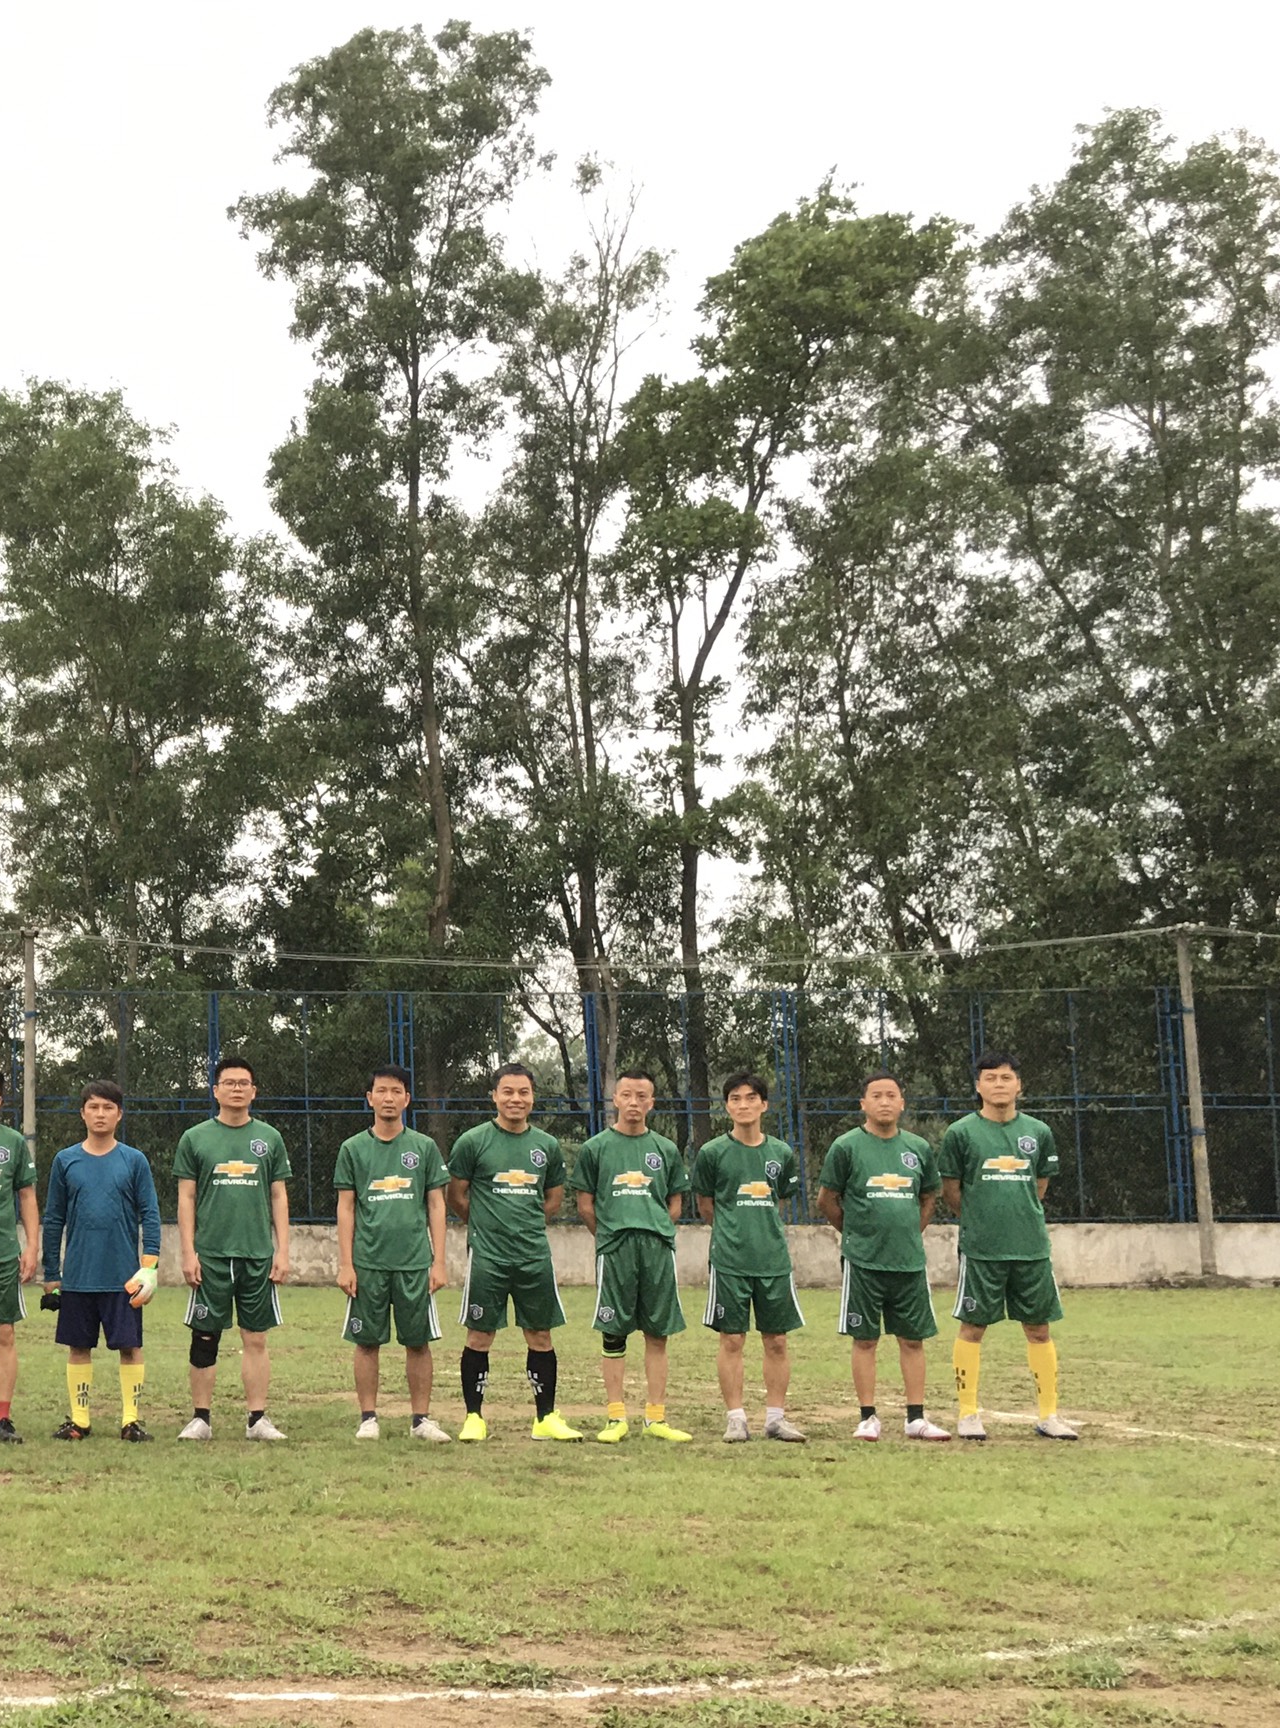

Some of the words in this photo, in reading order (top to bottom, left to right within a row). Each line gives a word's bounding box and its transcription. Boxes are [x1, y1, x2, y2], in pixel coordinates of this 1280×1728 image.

[981, 1174, 1031, 1182] CHEVROLET
[492, 1187, 538, 1196] CHEVROLET
[866, 1191, 914, 1199] CHEVROLET
[367, 1193, 414, 1202] CHEVROLET
